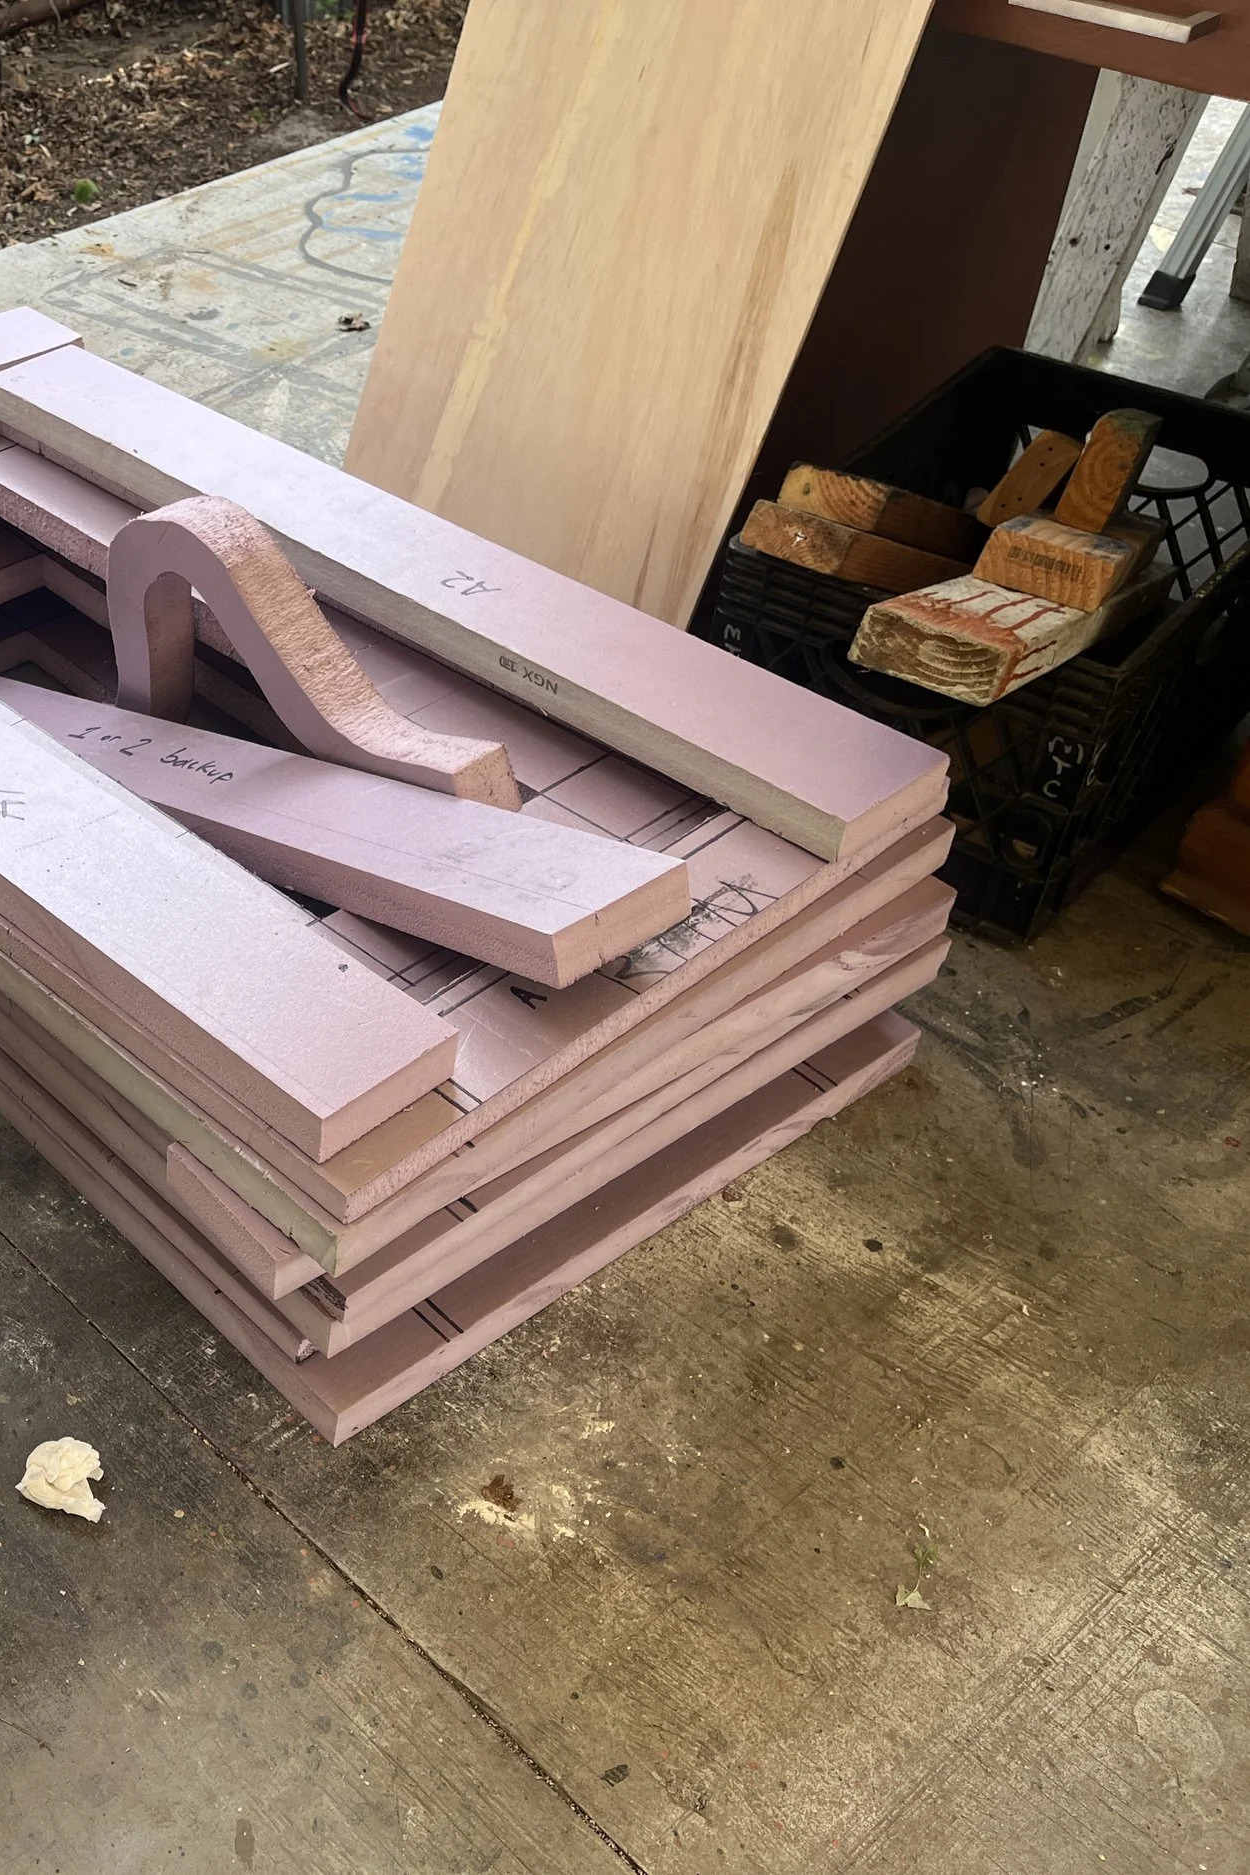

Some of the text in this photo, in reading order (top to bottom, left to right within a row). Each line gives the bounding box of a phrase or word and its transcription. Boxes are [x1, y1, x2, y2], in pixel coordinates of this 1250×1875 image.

[523, 666, 558, 694] NGX
[119, 738, 152, 756] 2
[160, 747, 233, 784] backup
